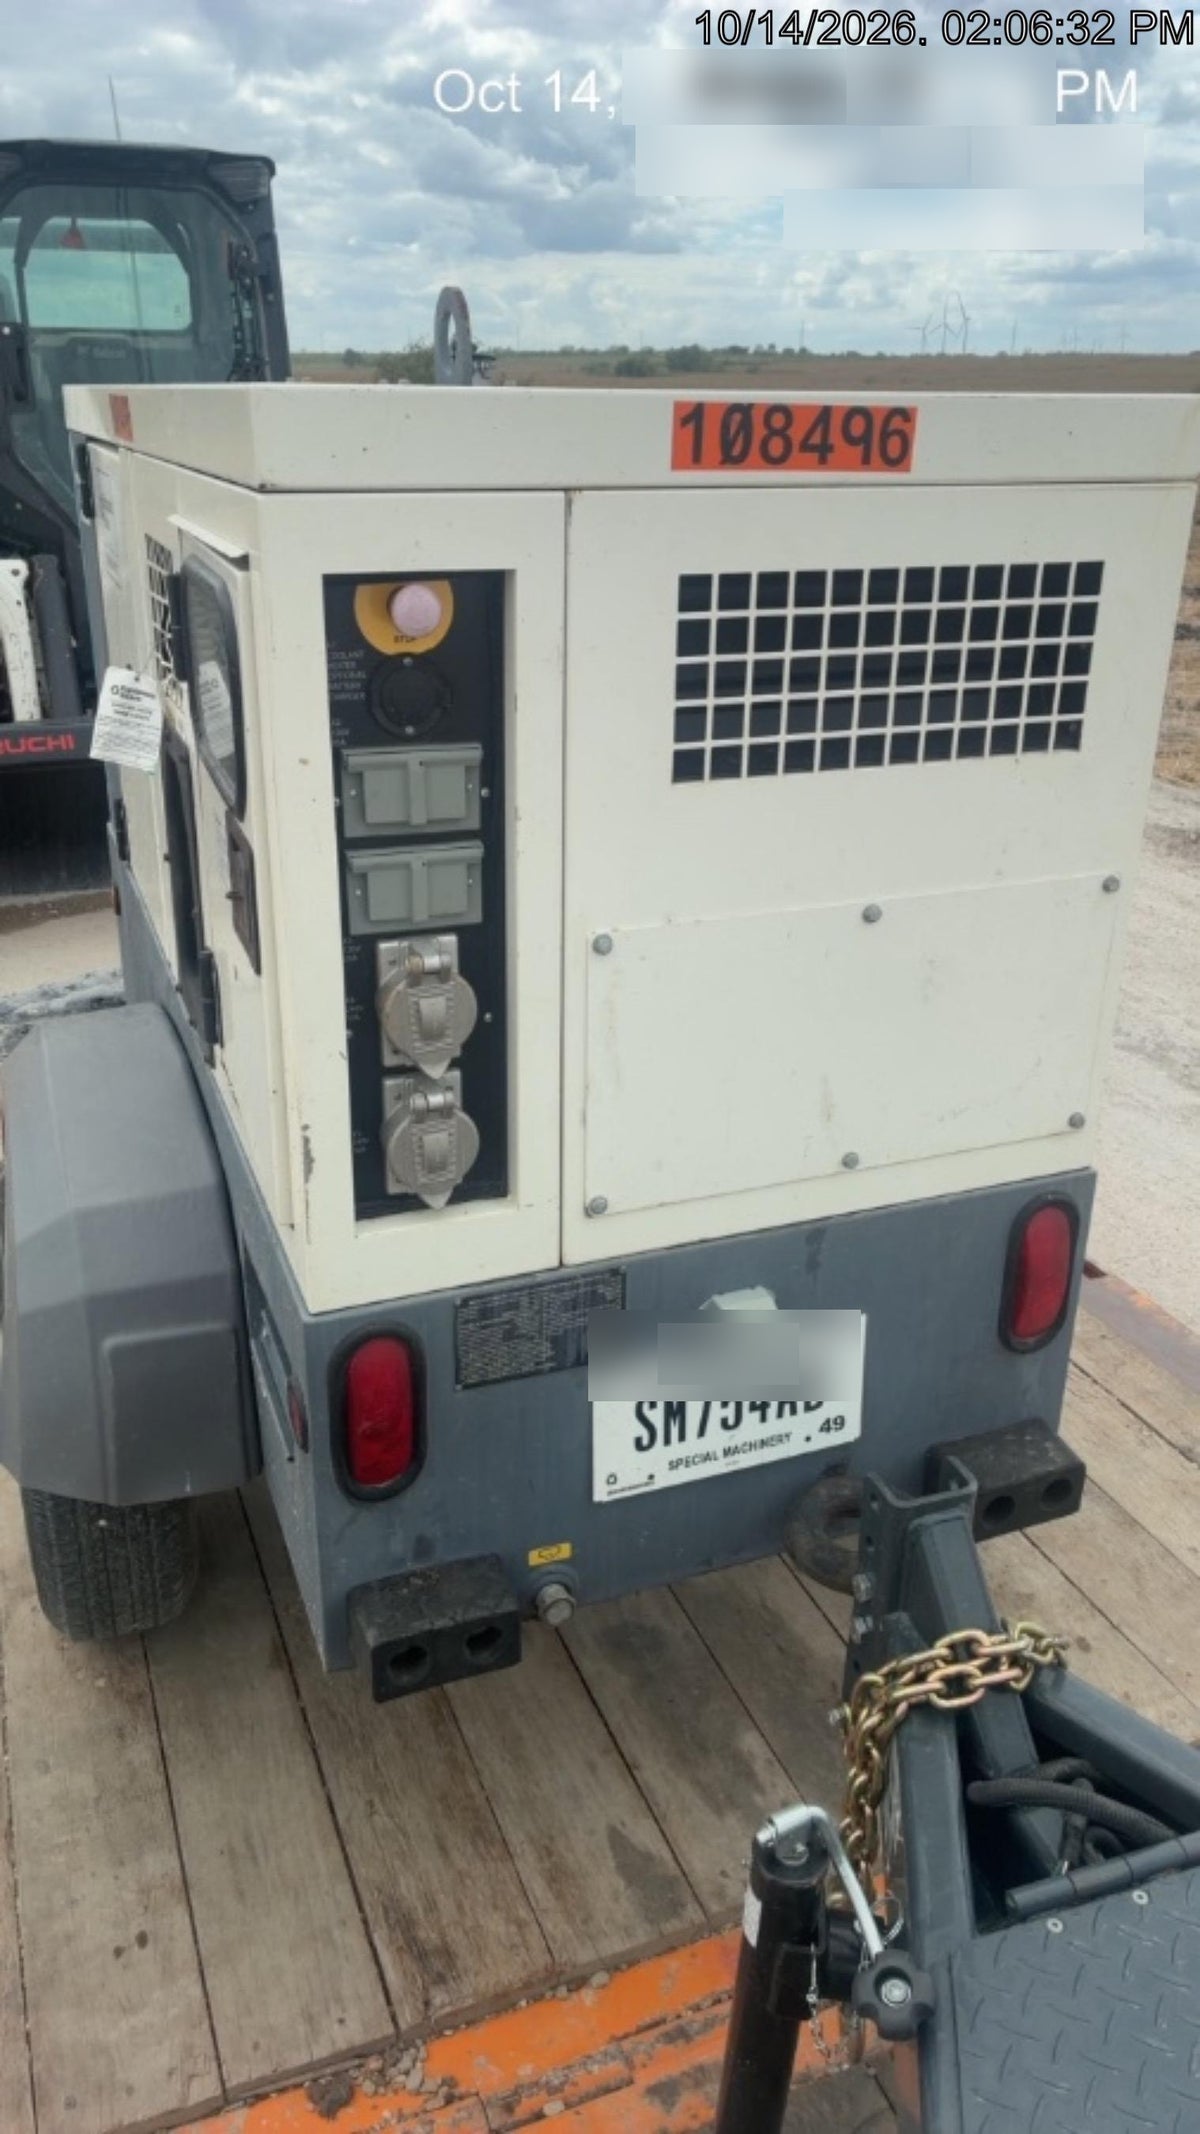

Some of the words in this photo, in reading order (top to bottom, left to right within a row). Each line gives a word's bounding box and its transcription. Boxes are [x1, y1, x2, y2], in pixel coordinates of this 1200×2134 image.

[680, 401, 913, 468] 108496
[0, 733, 75, 755] UCHI
[818, 1415, 846, 1434] 49
[668, 1451, 720, 1472] SPECIAL
[722, 1432, 793, 1458] MACHINERY
